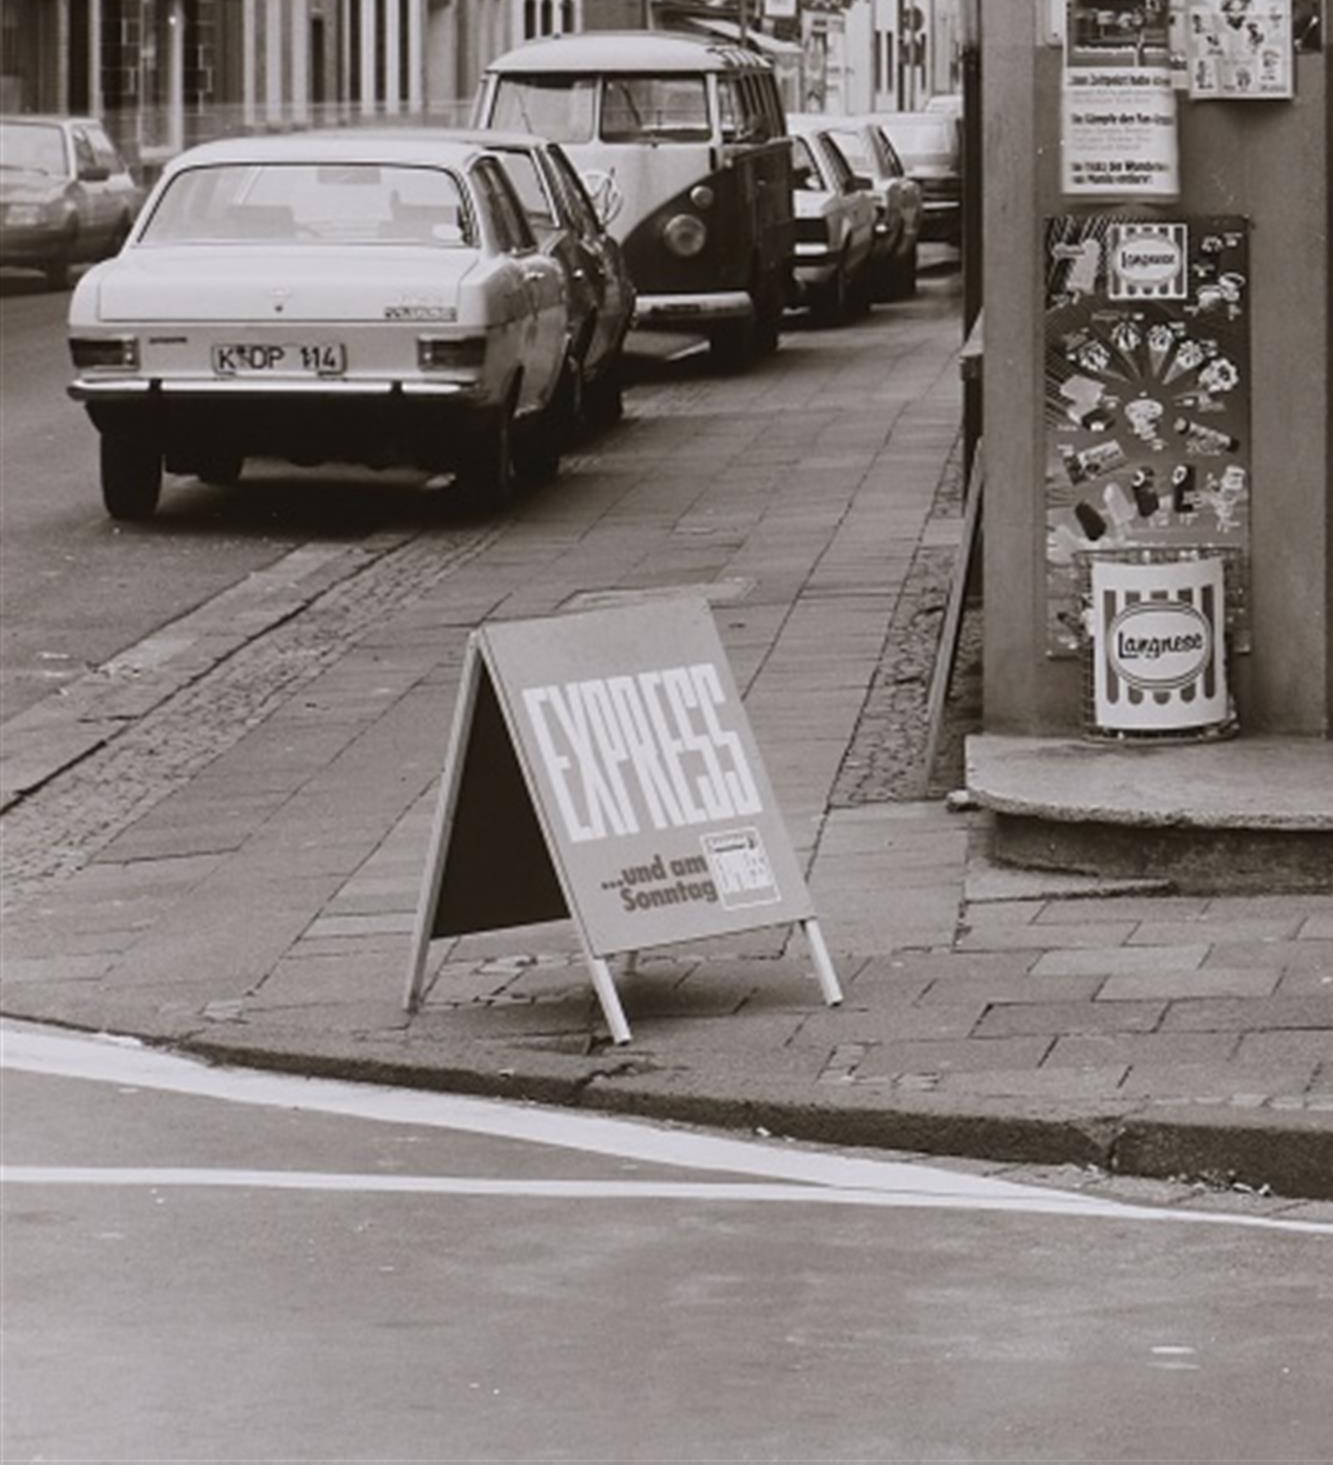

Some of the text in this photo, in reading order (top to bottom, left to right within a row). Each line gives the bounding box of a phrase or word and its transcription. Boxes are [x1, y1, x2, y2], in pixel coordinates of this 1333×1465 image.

[218, 349, 237, 370] K
[1117, 630, 1203, 659] Langnese
[521, 662, 764, 844] EXPRESS
[670, 855, 708, 876] am
[620, 875, 719, 912] Sonntag
